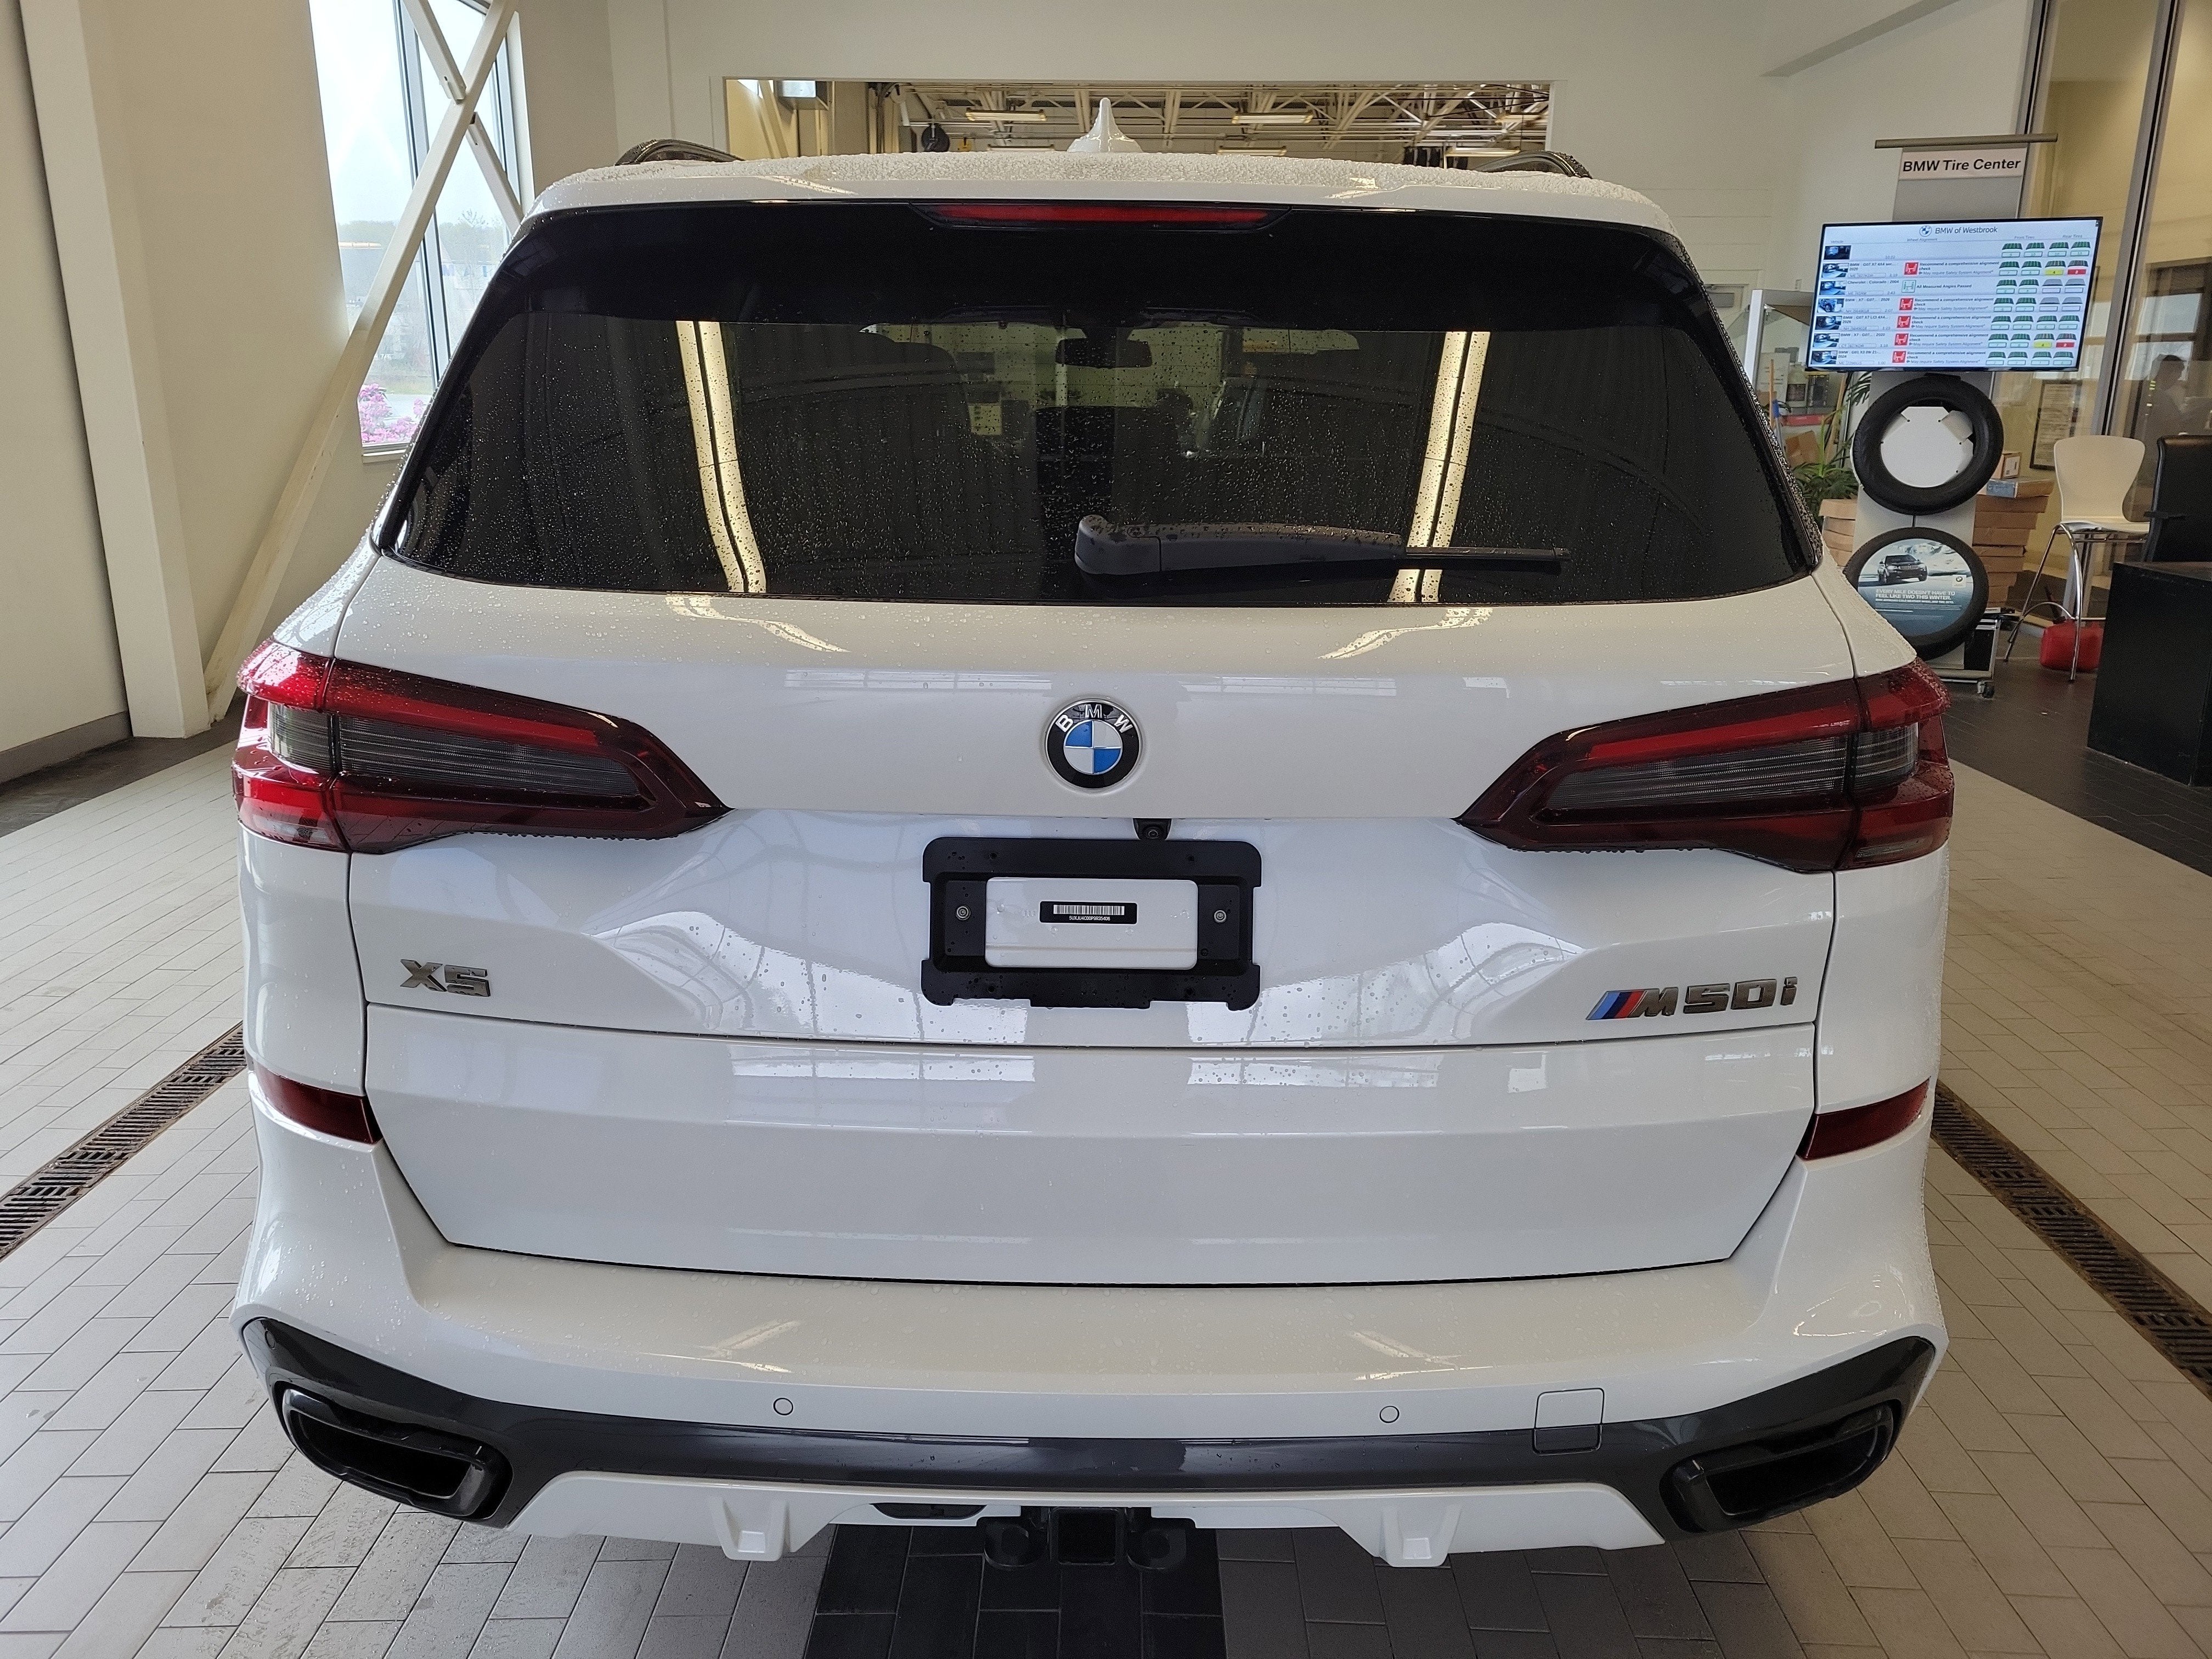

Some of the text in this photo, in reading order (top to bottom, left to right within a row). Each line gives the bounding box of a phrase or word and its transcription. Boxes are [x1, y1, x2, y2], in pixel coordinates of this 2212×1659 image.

[1903, 159, 2021, 172] BMW Tire Center
[1056, 704, 1133, 733] BMW
[400, 959, 490, 997] X5
